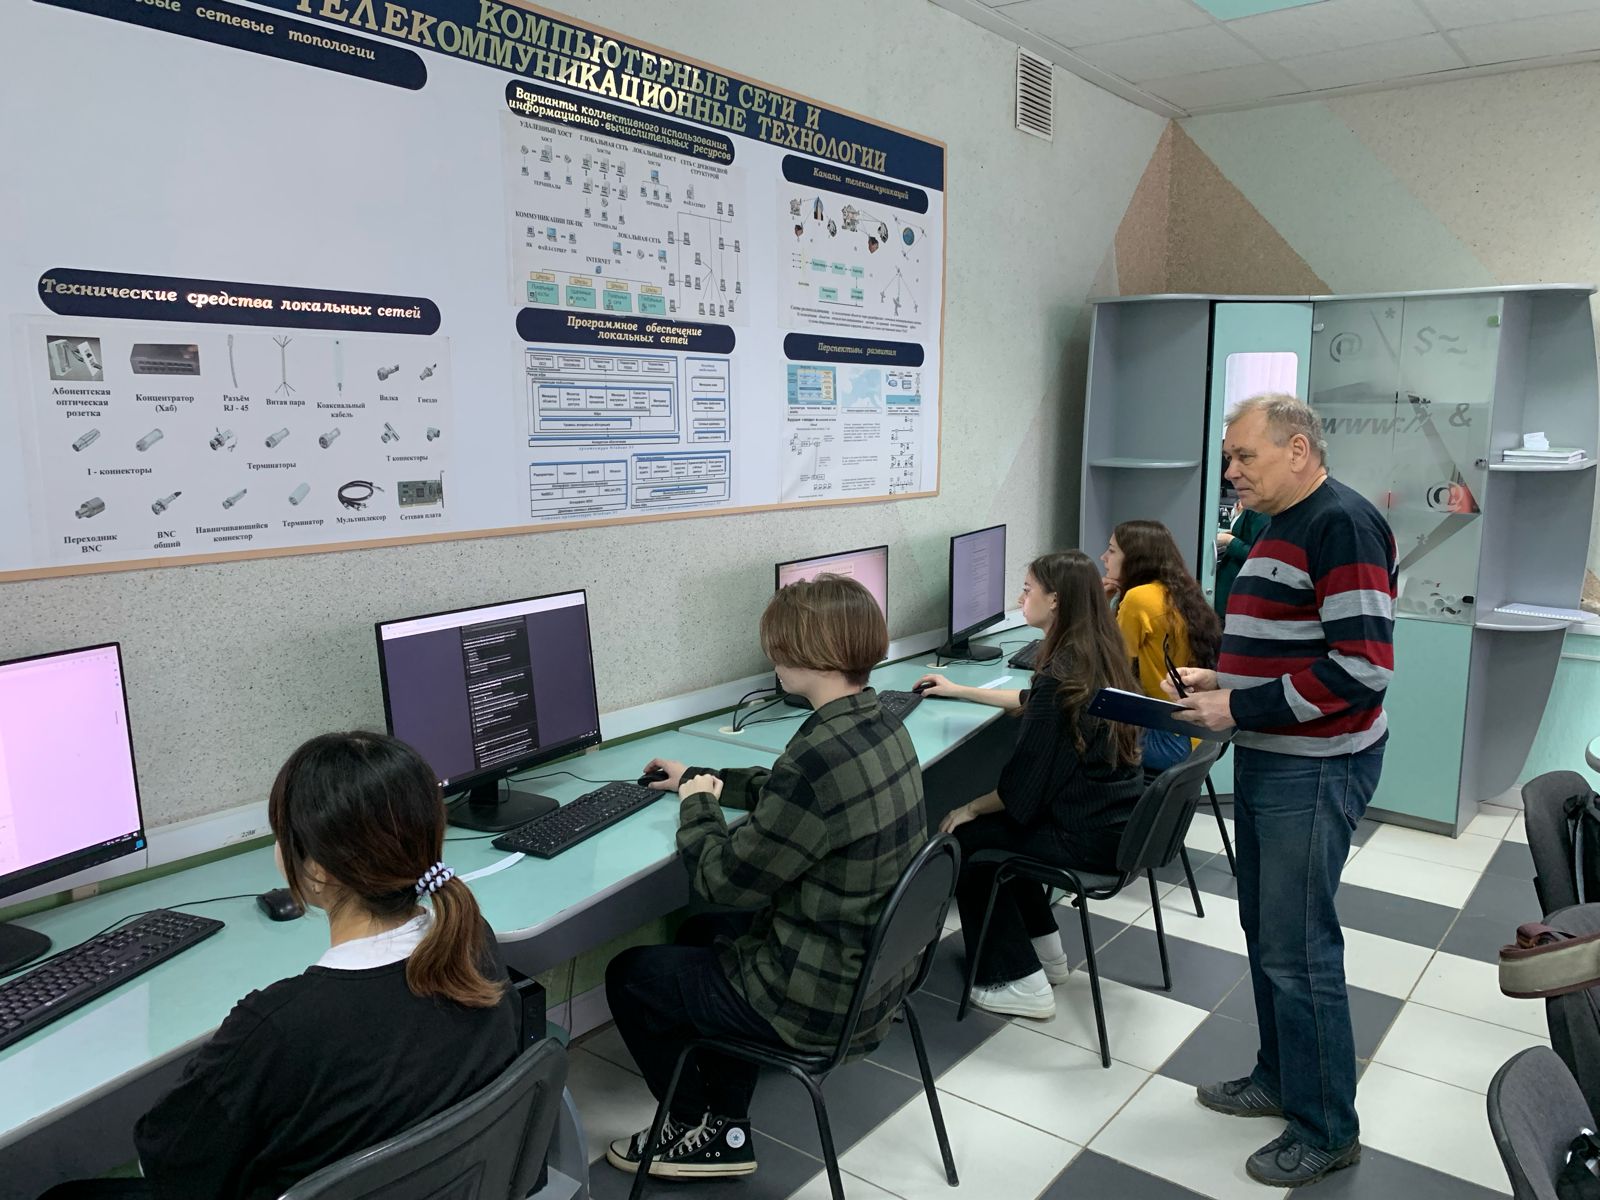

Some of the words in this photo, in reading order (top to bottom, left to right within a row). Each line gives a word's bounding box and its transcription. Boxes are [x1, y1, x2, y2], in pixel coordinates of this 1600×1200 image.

[196, 7, 274, 35] сетевые
[288, 30, 376, 60] топологии
[477, 1, 729, 101] КОМПЬЮТЕРНЫЕ
[738, 84, 796, 122] СЕТИ
[804, 105, 822, 130] И
[515, 86, 577, 112] Варианты
[581, 105, 659, 133] коллективного
[661, 126, 728, 151] использования
[615, 142, 628, 151] СЕТЬ
[758, 114, 887, 173] ТЕХНОЛОГИИ
[692, 143, 732, 160] ресурсов
[813, 167, 841, 182] Каналы
[845, 176, 910, 199] телекоммуникаций
[585, 256, 611, 265] INTERNET
[41, 277, 178, 303] Технические
[187, 290, 273, 309] средства
[281, 298, 372, 316] локальных
[377, 304, 422, 319] сетей
[567, 315, 638, 332] Программное
[646, 324, 703, 337] обеспечение
[597, 329, 654, 344] локальных
[660, 333, 689, 346] сетей
[817, 342, 863, 355] Перспективы
[866, 346, 897, 357] развития
[51, 387, 111, 396] Абонентская
[56, 398, 109, 407] оптическая
[135, 393, 195, 403] Концентратор
[223, 394, 250, 402] Разъём
[265, 398, 288, 406] Витая
[289, 400, 306, 408] пара
[155, 404, 178, 413] (Хаб)
[224, 404, 234, 412] RJ
[240, 404, 249, 412] 45
[316, 401, 366, 409] Коаксиальный
[66, 409, 101, 419] розетка
[330, 410, 354, 418] кабель
[247, 461, 297, 471] Терминаторы
[336, 513, 387, 524] Мультиплексор
[400, 513, 424, 521] Сетевая
[425, 511, 442, 519] плата
[282, 517, 324, 527] Терминатор
[63, 532, 118, 545] Переходник
[157, 530, 176, 539] BNC
[81, 544, 102, 554] BNC
